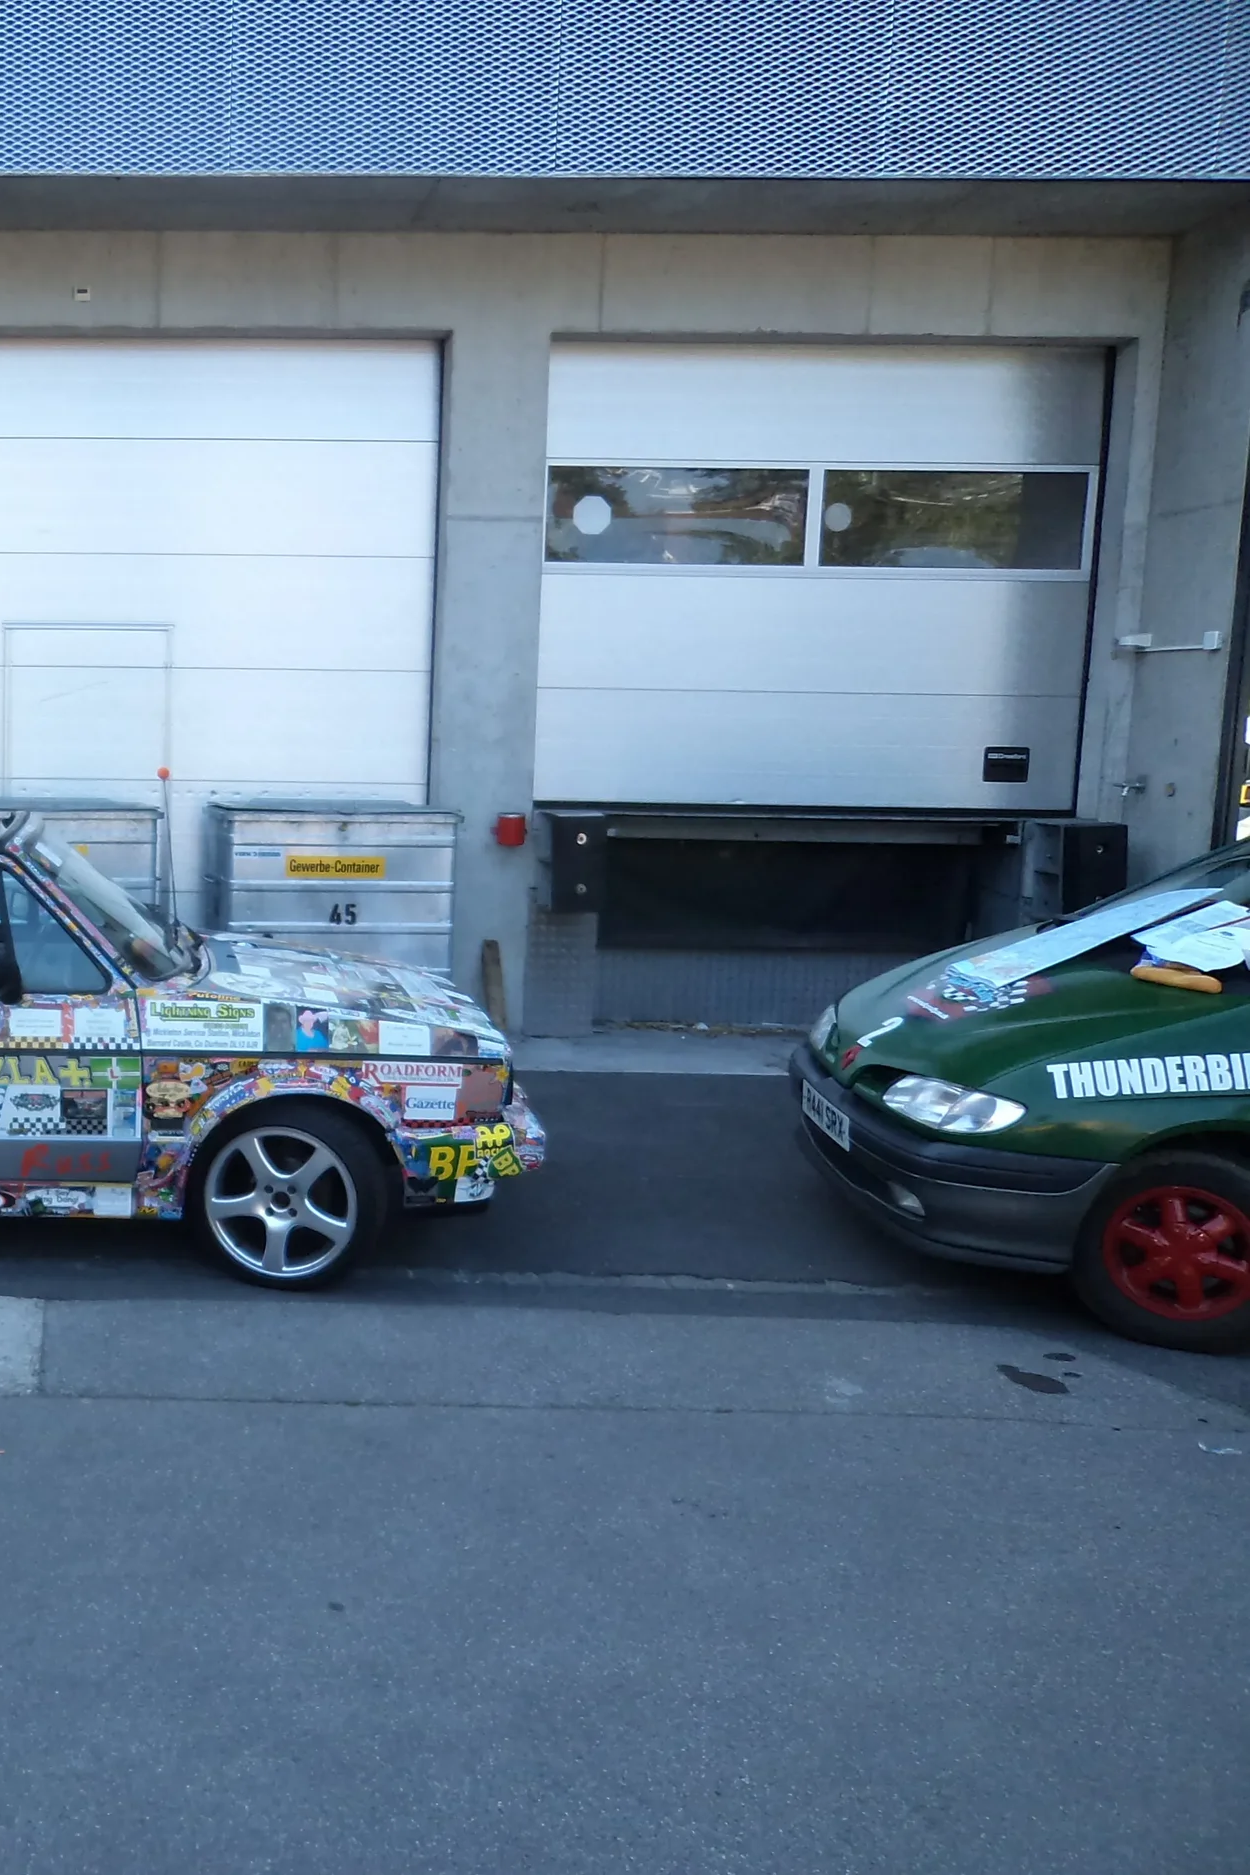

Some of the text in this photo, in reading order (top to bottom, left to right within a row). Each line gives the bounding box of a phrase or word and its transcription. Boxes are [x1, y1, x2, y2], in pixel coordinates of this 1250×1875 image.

[289, 858, 380, 875] Gewerbe-Container
[329, 903, 357, 925] 45
[363, 1062, 464, 1080] ROADFORM
[406, 1097, 456, 1110] Gazette
[430, 1145, 479, 1180] BP
[477, 1149, 505, 1158] RACI
[493, 1151, 520, 1177] BP
